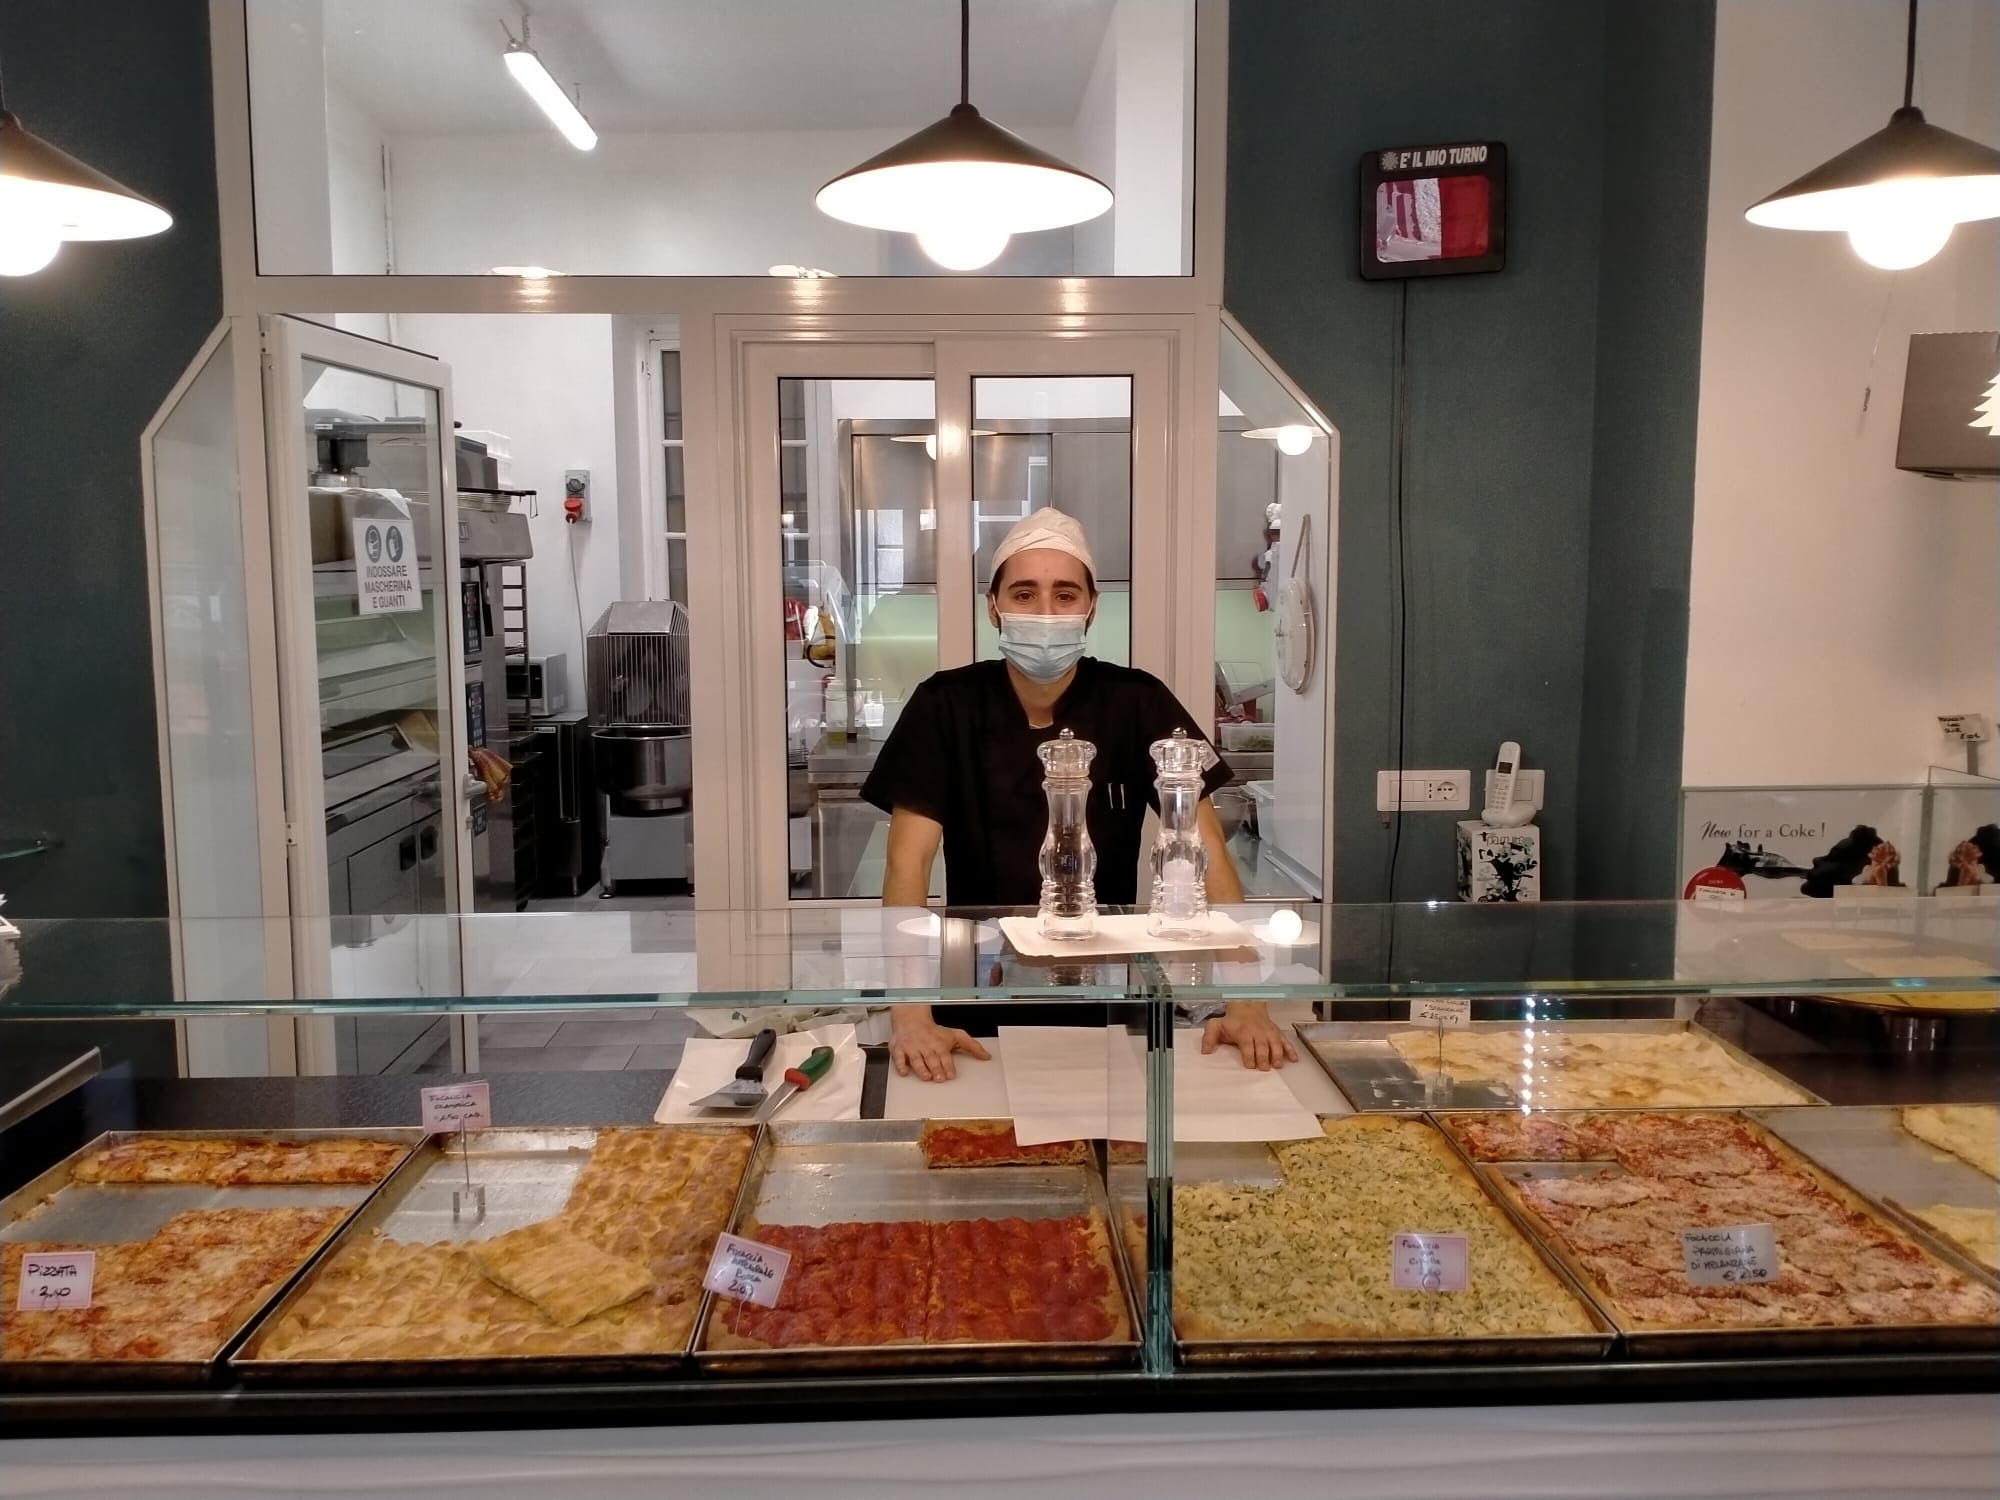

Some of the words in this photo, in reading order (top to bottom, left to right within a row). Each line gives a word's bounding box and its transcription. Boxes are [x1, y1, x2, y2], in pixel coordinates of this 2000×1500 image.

[1400, 152, 1411, 168] E'
[1412, 152, 1422, 168] IL
[1425, 149, 1447, 167] MIO
[1449, 146, 1488, 165] TURNO
[366, 565, 408, 578] INDOSSARE
[364, 580, 413, 594] MASCHERINA
[372, 596, 378, 608] E
[379, 594, 406, 608] GUANTI
[1701, 821, 1731, 840] Now
[1738, 823, 1760, 838] for
[1765, 829, 1773, 838] a
